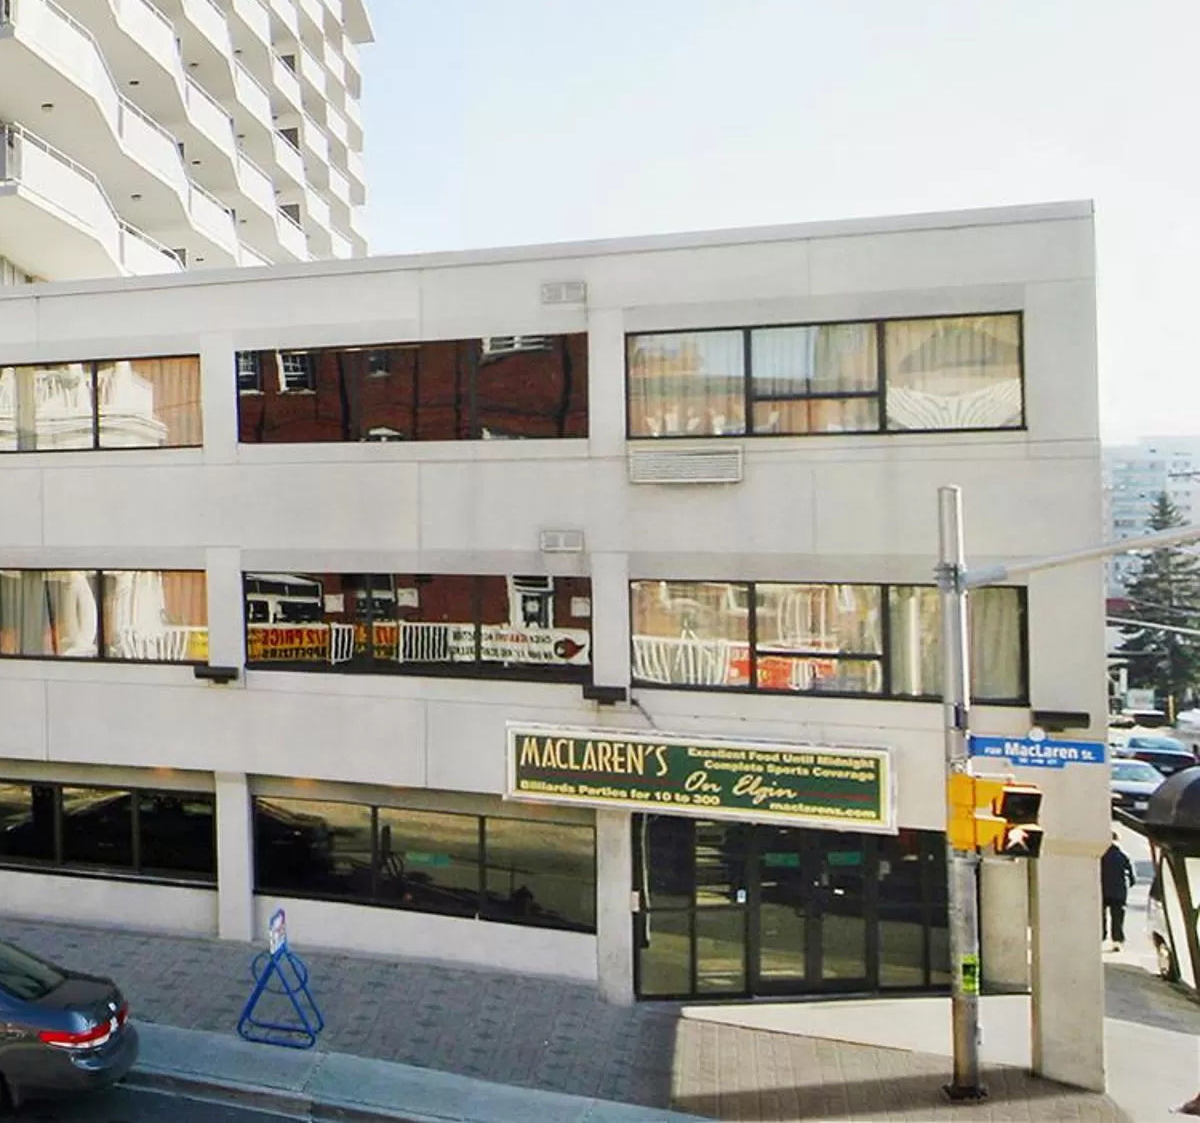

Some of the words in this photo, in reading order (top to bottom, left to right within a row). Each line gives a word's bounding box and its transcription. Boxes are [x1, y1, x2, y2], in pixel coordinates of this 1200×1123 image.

[520, 737, 668, 777] MACLAREN'S
[687, 747, 746, 761] Excellent
[749, 751, 781, 762] Food
[816, 755, 876, 770] Midnight
[1004, 742, 1078, 759] MacLaren
[704, 759, 764, 773] Complete
[766, 763, 810, 777] Sports
[812, 766, 876, 782] Coverage
[520, 779, 576, 794] Billiards
[579, 784, 628, 799] Parties
[631, 789, 651, 800] for
[654, 790, 672, 802] 10
[675, 792, 690, 804] to
[684, 771, 722, 793] On
[731, 774, 798, 805] Elgin
